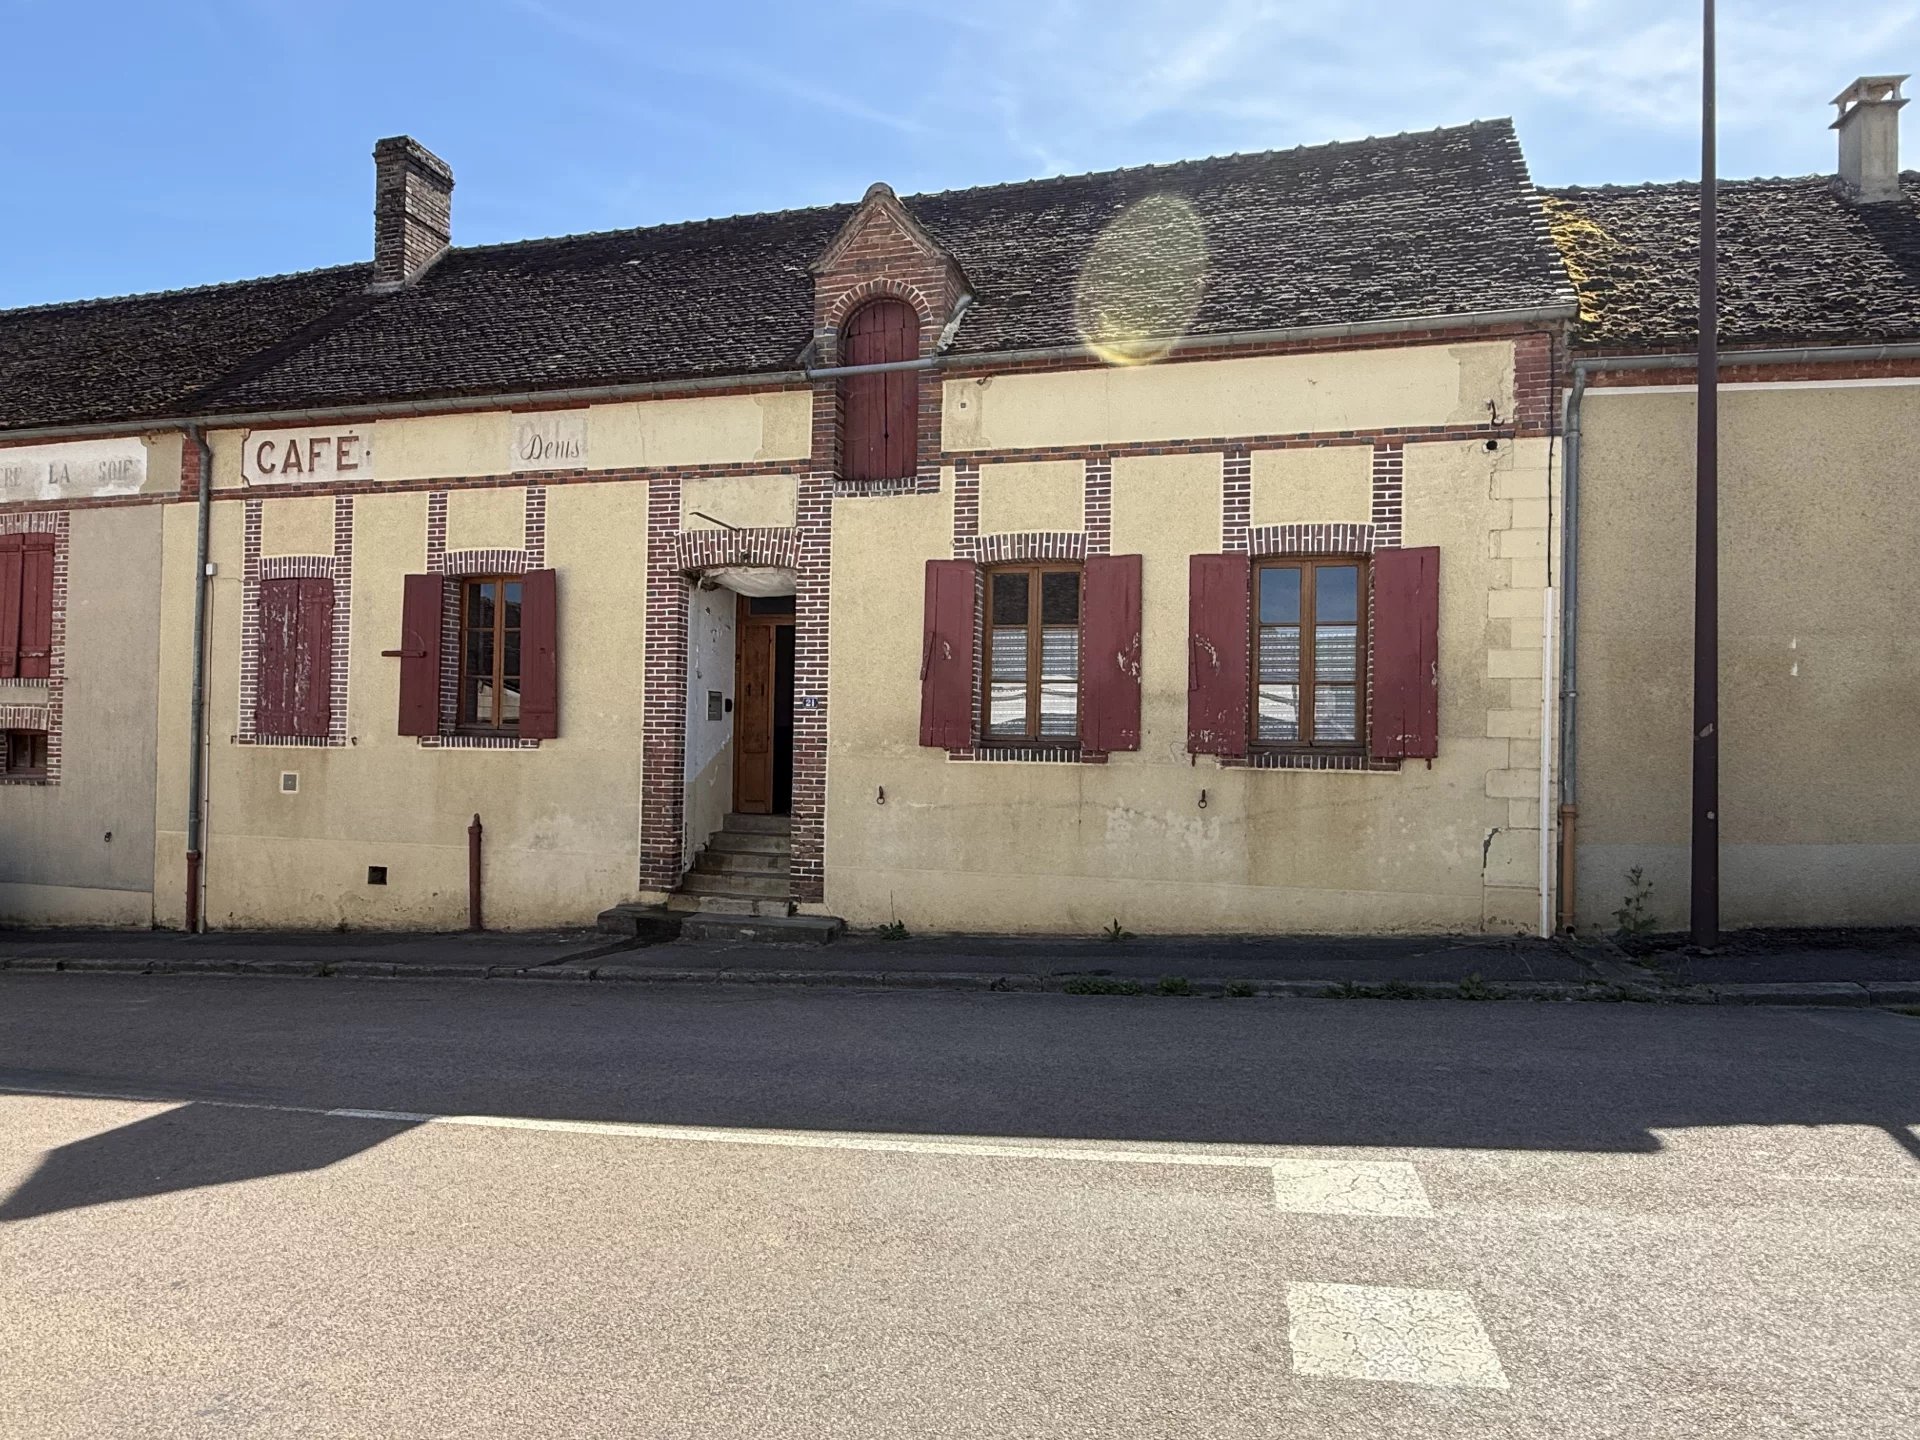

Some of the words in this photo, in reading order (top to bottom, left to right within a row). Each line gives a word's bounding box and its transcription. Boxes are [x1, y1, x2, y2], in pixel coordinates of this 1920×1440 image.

[520, 433, 580, 461] Denis
[48, 462, 70, 484] LA
[805, 698, 815, 707] 21
